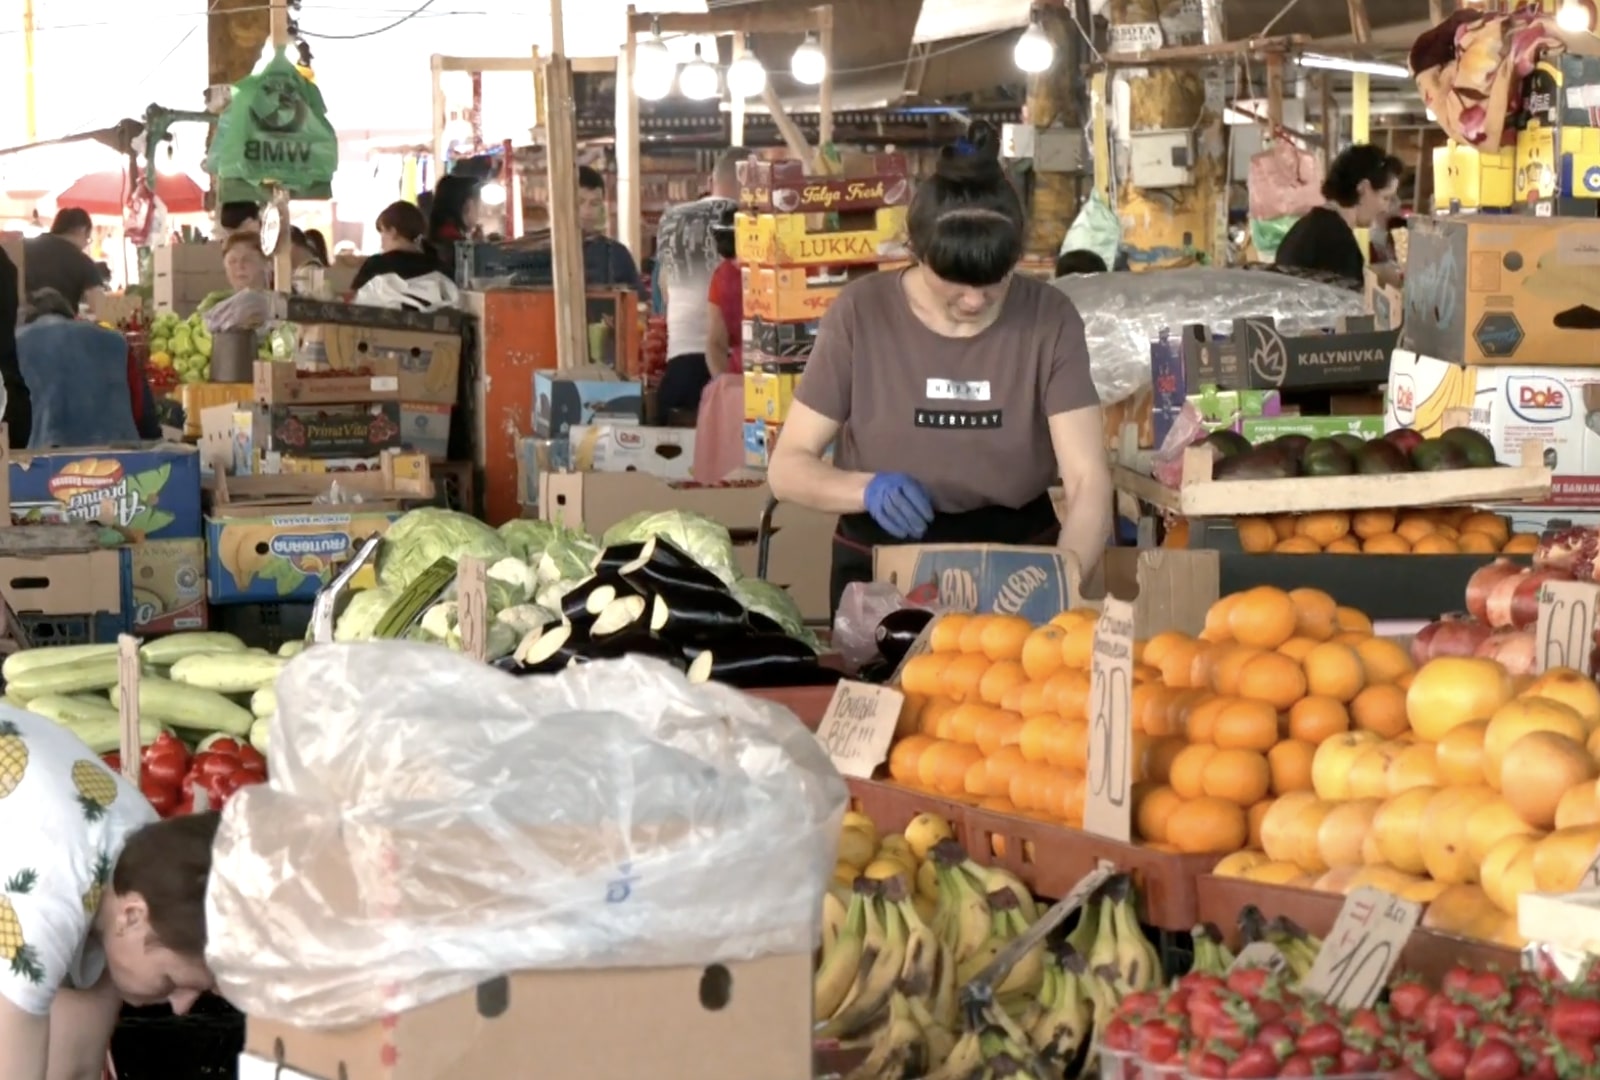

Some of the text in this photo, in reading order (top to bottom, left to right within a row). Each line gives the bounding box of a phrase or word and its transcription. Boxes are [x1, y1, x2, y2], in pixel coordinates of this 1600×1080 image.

[801, 182, 884, 207] Talya Fresh
[800, 238, 873, 258] LUKKA
[1297, 349, 1385, 366] KALYNIVKA
[1397, 384, 1414, 408] Dole
[1519, 385, 1564, 407] Dole
[918, 413, 999, 426] EVERYDAY
[1543, 599, 1587, 672] 60
